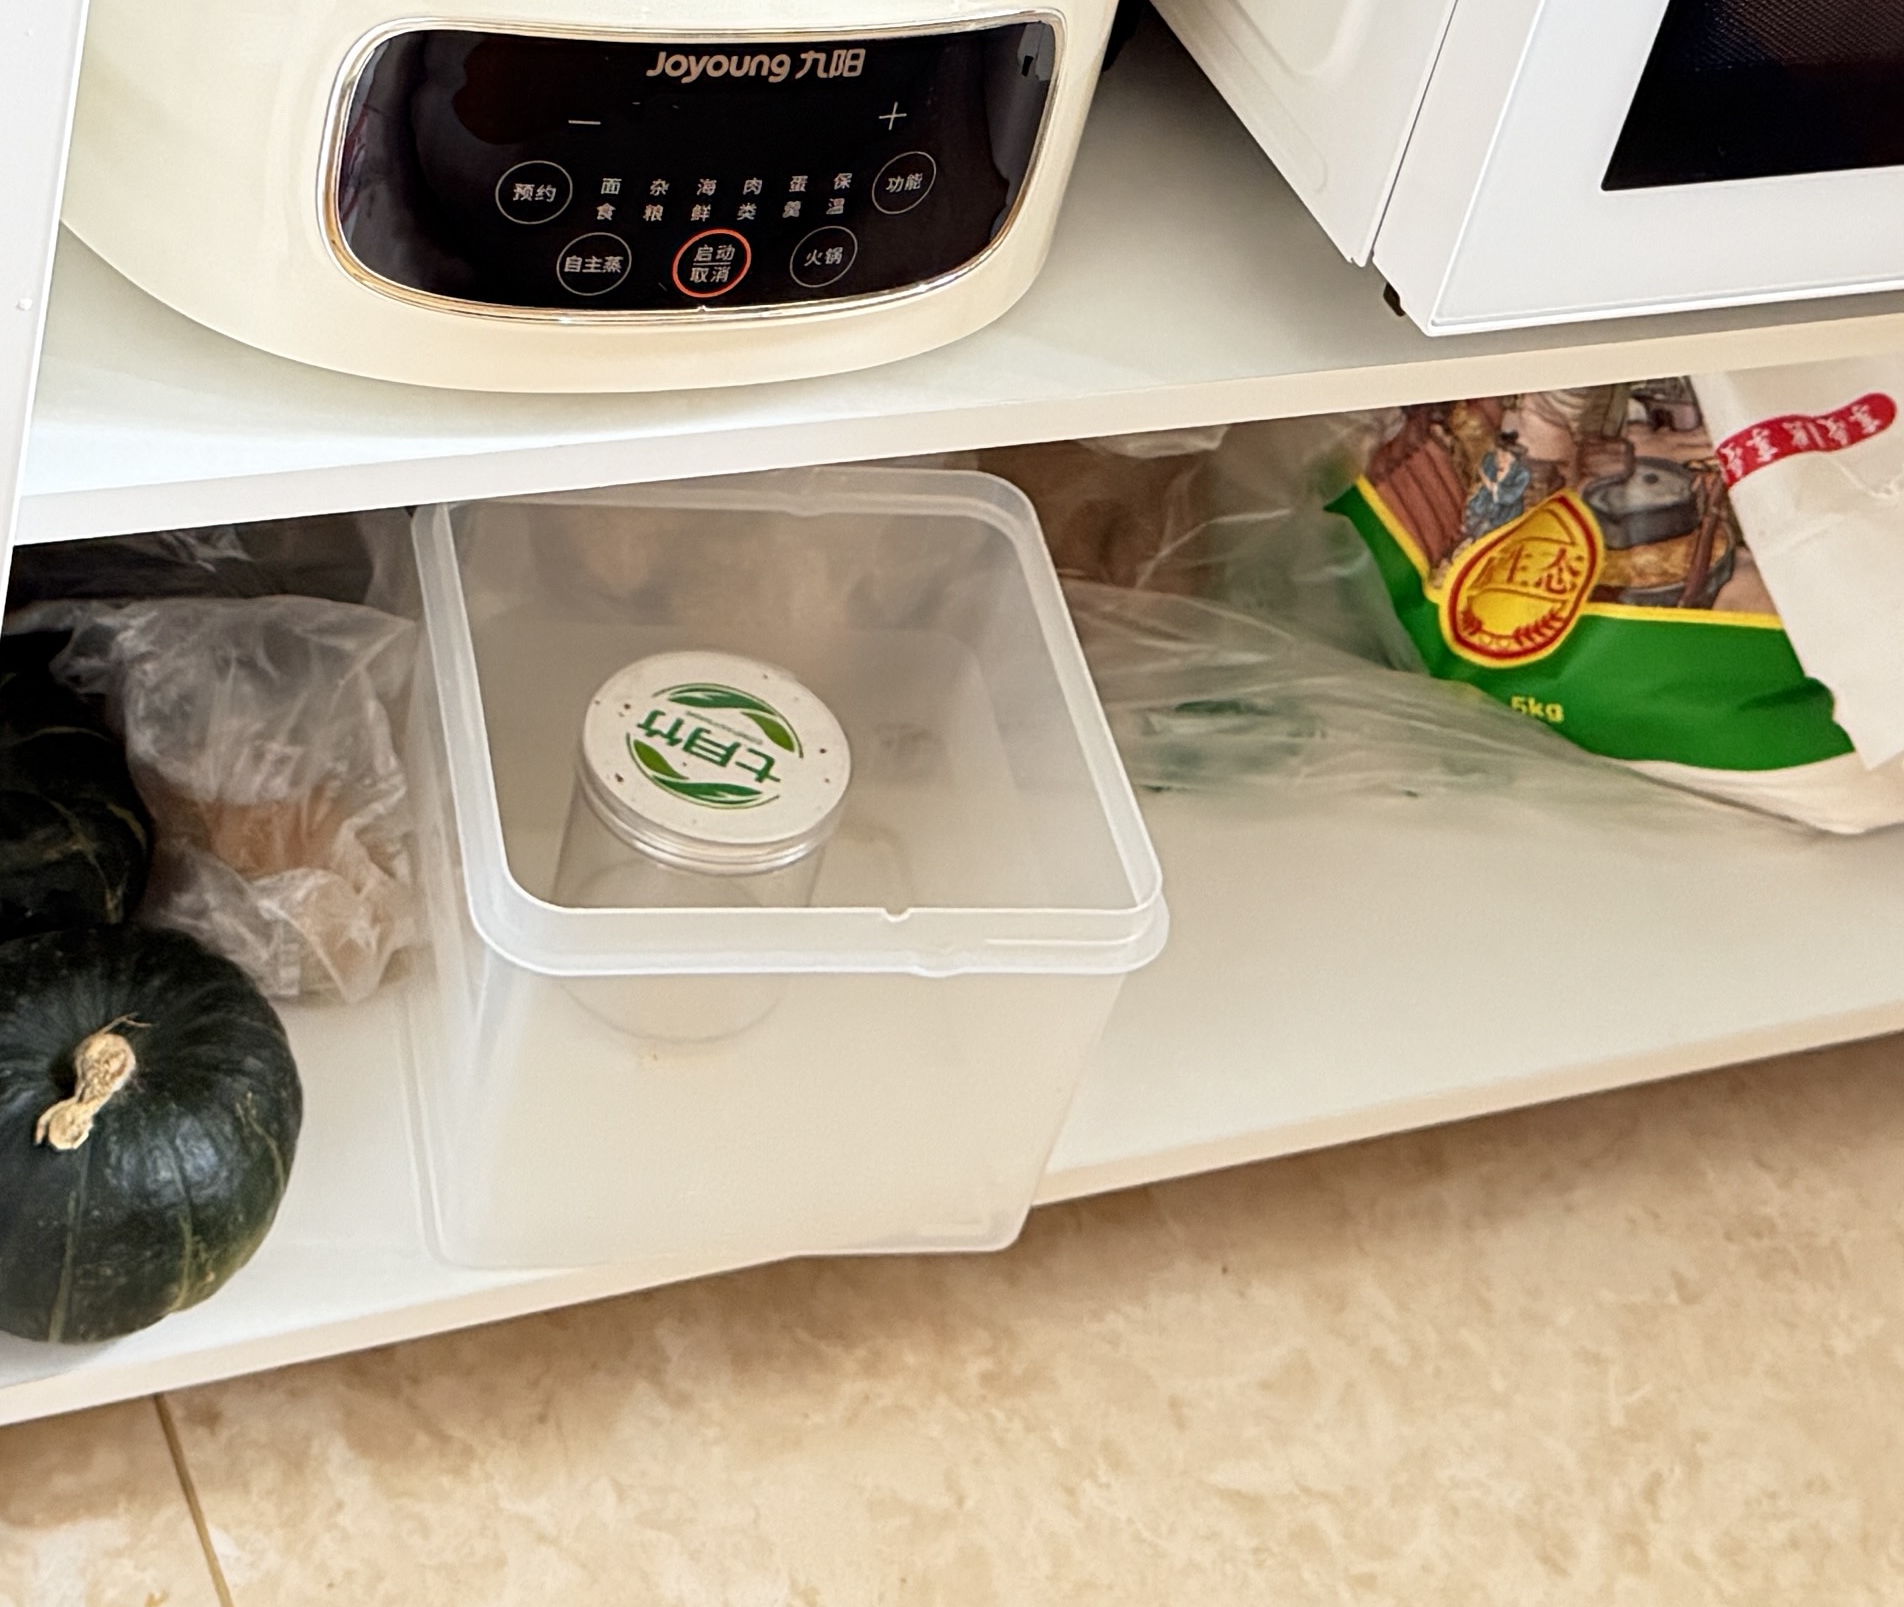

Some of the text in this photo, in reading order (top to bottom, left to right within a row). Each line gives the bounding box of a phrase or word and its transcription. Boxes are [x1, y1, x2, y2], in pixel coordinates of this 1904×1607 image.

[645, 48, 866, 84] Joyoung 九阳
[511, 180, 557, 205] 预约
[884, 171, 925, 196] 功能
[563, 255, 625, 274] 自主蒸
[693, 243, 737, 262] 启动
[803, 246, 844, 267] 火锅
[689, 266, 731, 284] 取消
[1510, 694, 1565, 724] 5kg
[636, 709, 782, 784] 七月竹
